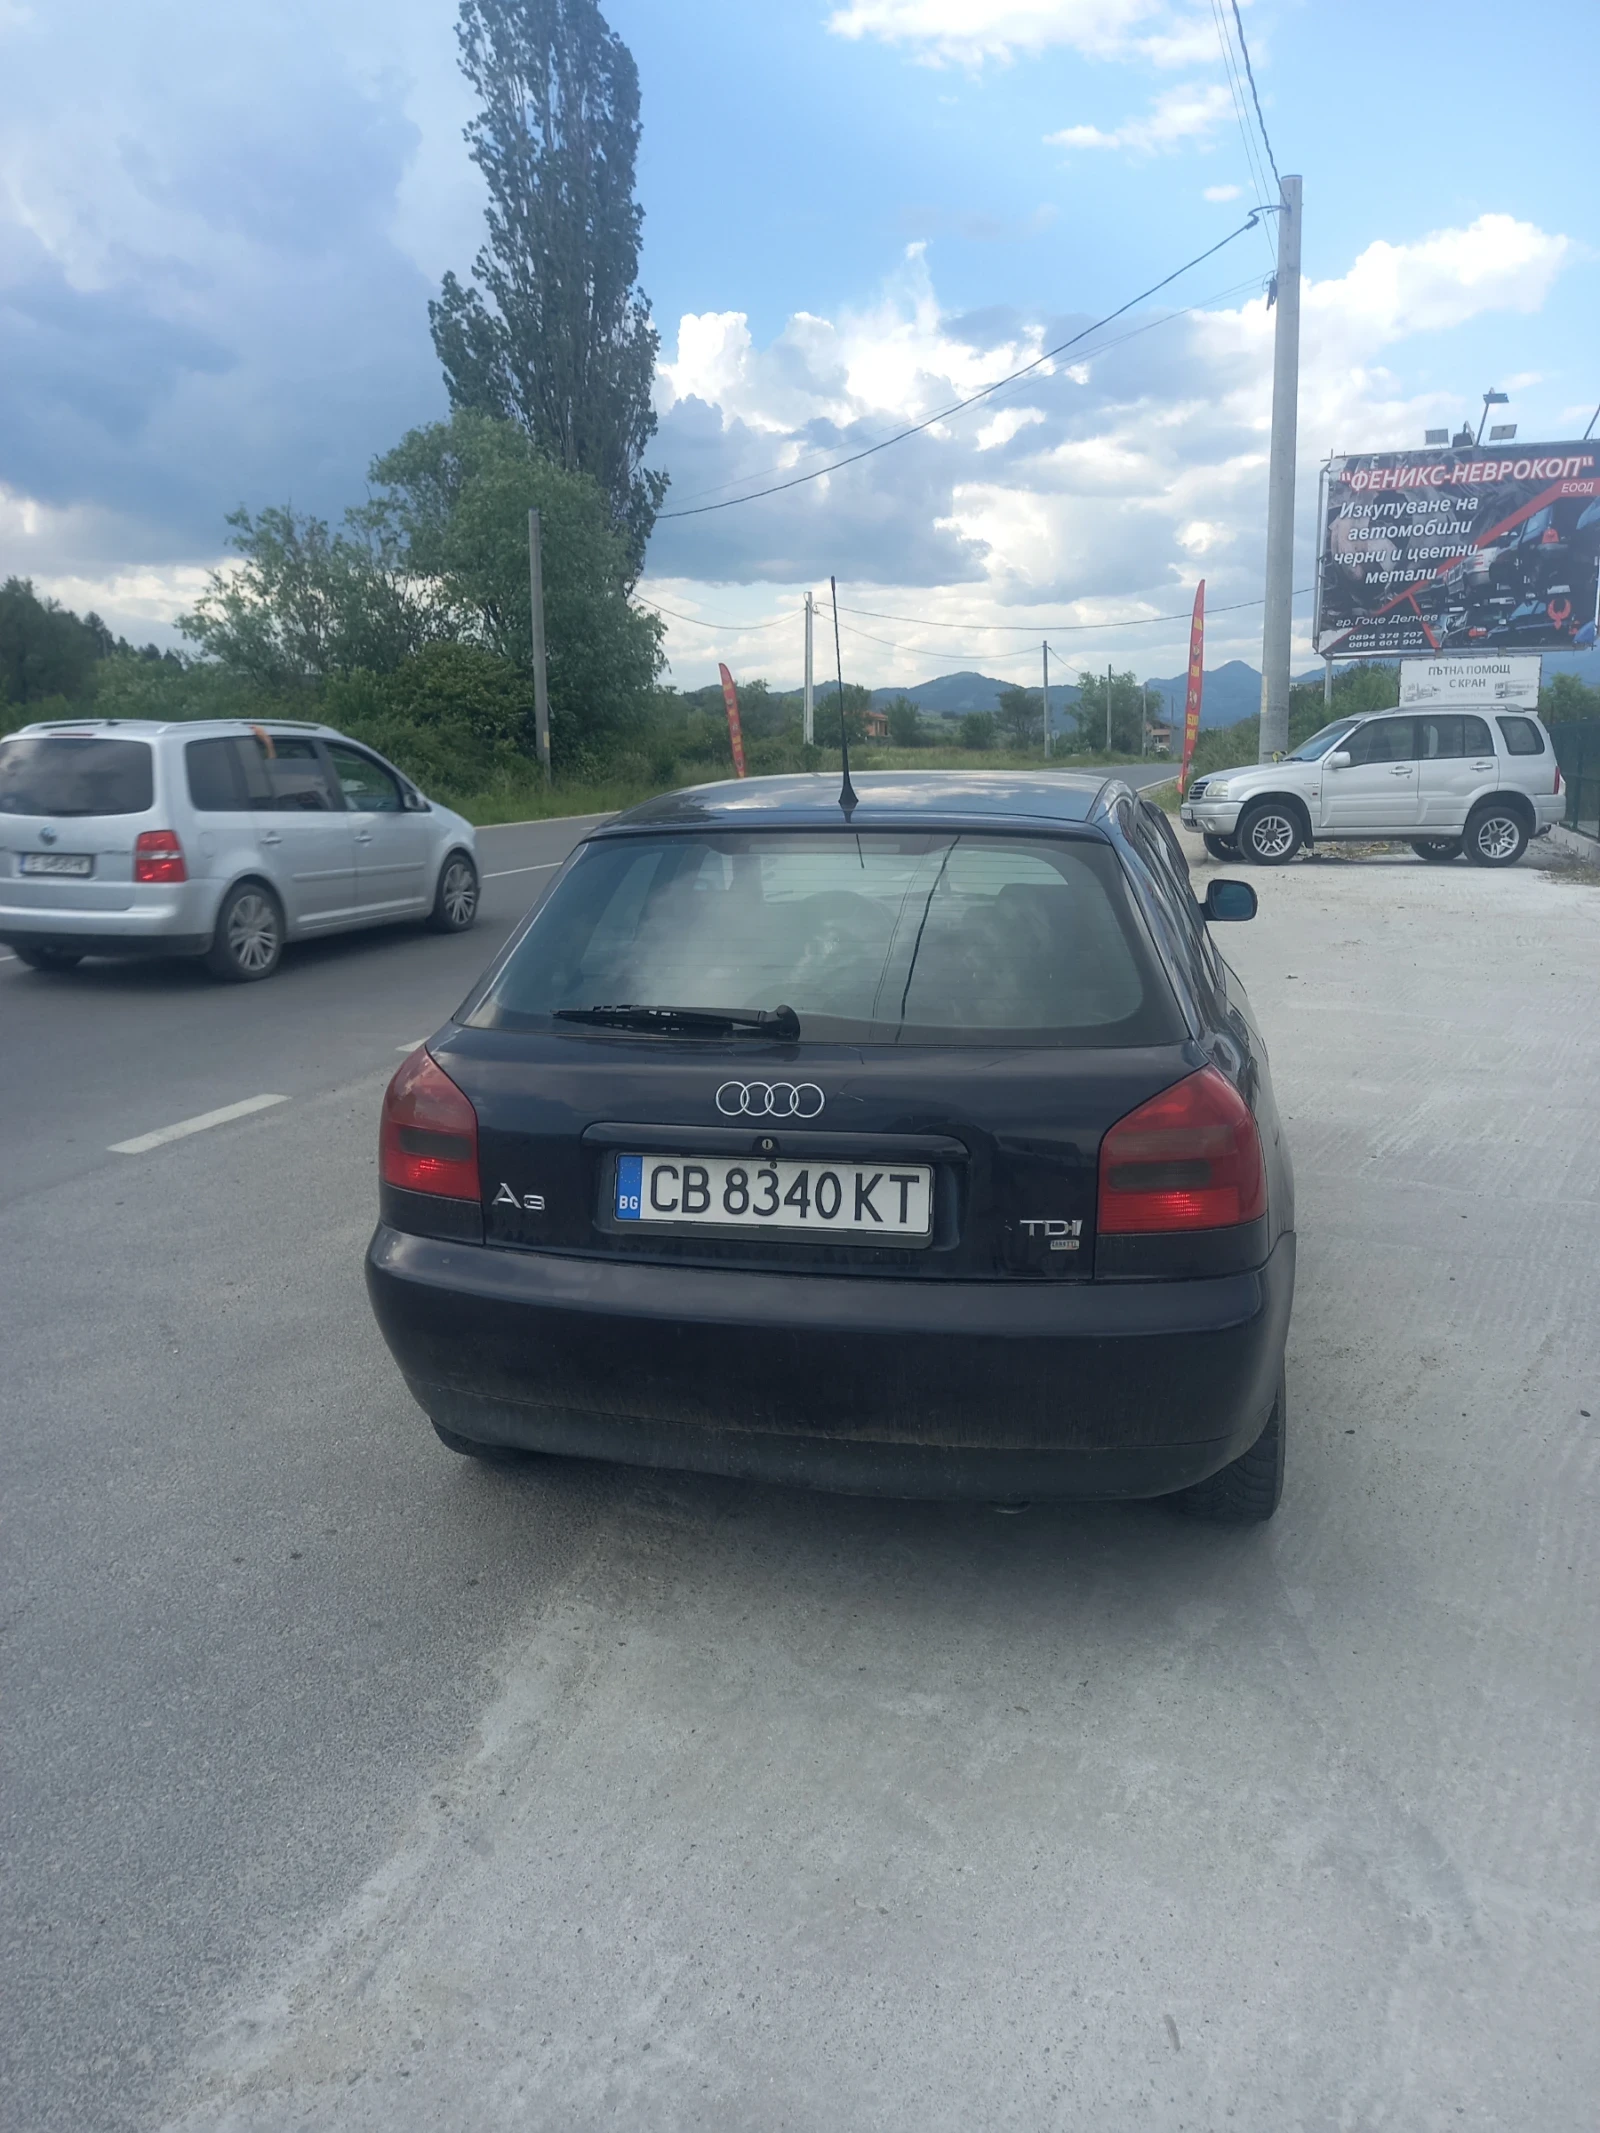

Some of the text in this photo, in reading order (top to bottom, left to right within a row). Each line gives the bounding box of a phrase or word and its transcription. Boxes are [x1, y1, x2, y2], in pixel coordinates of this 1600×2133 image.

[1561, 482, 1594, 494] ЕООД
[1340, 497, 1478, 520] Изкупуване на
[1348, 519, 1472, 540] автомобили
[1334, 544, 1478, 567] черни и цветни
[1365, 568, 1437, 584] метали
[1388, 614, 1438, 625] Делчев
[1379, 632, 1399, 640] 378
[1428, 664, 1511, 676] ПЪТНА ПОМОЩ
[1449, 679, 1456, 688] С
[1458, 678, 1486, 688] КРАН
[491, 1182, 545, 1210] A3
[619, 1165, 920, 1224] BG CB 8340 KT
[1019, 1219, 1083, 1236] TDI
